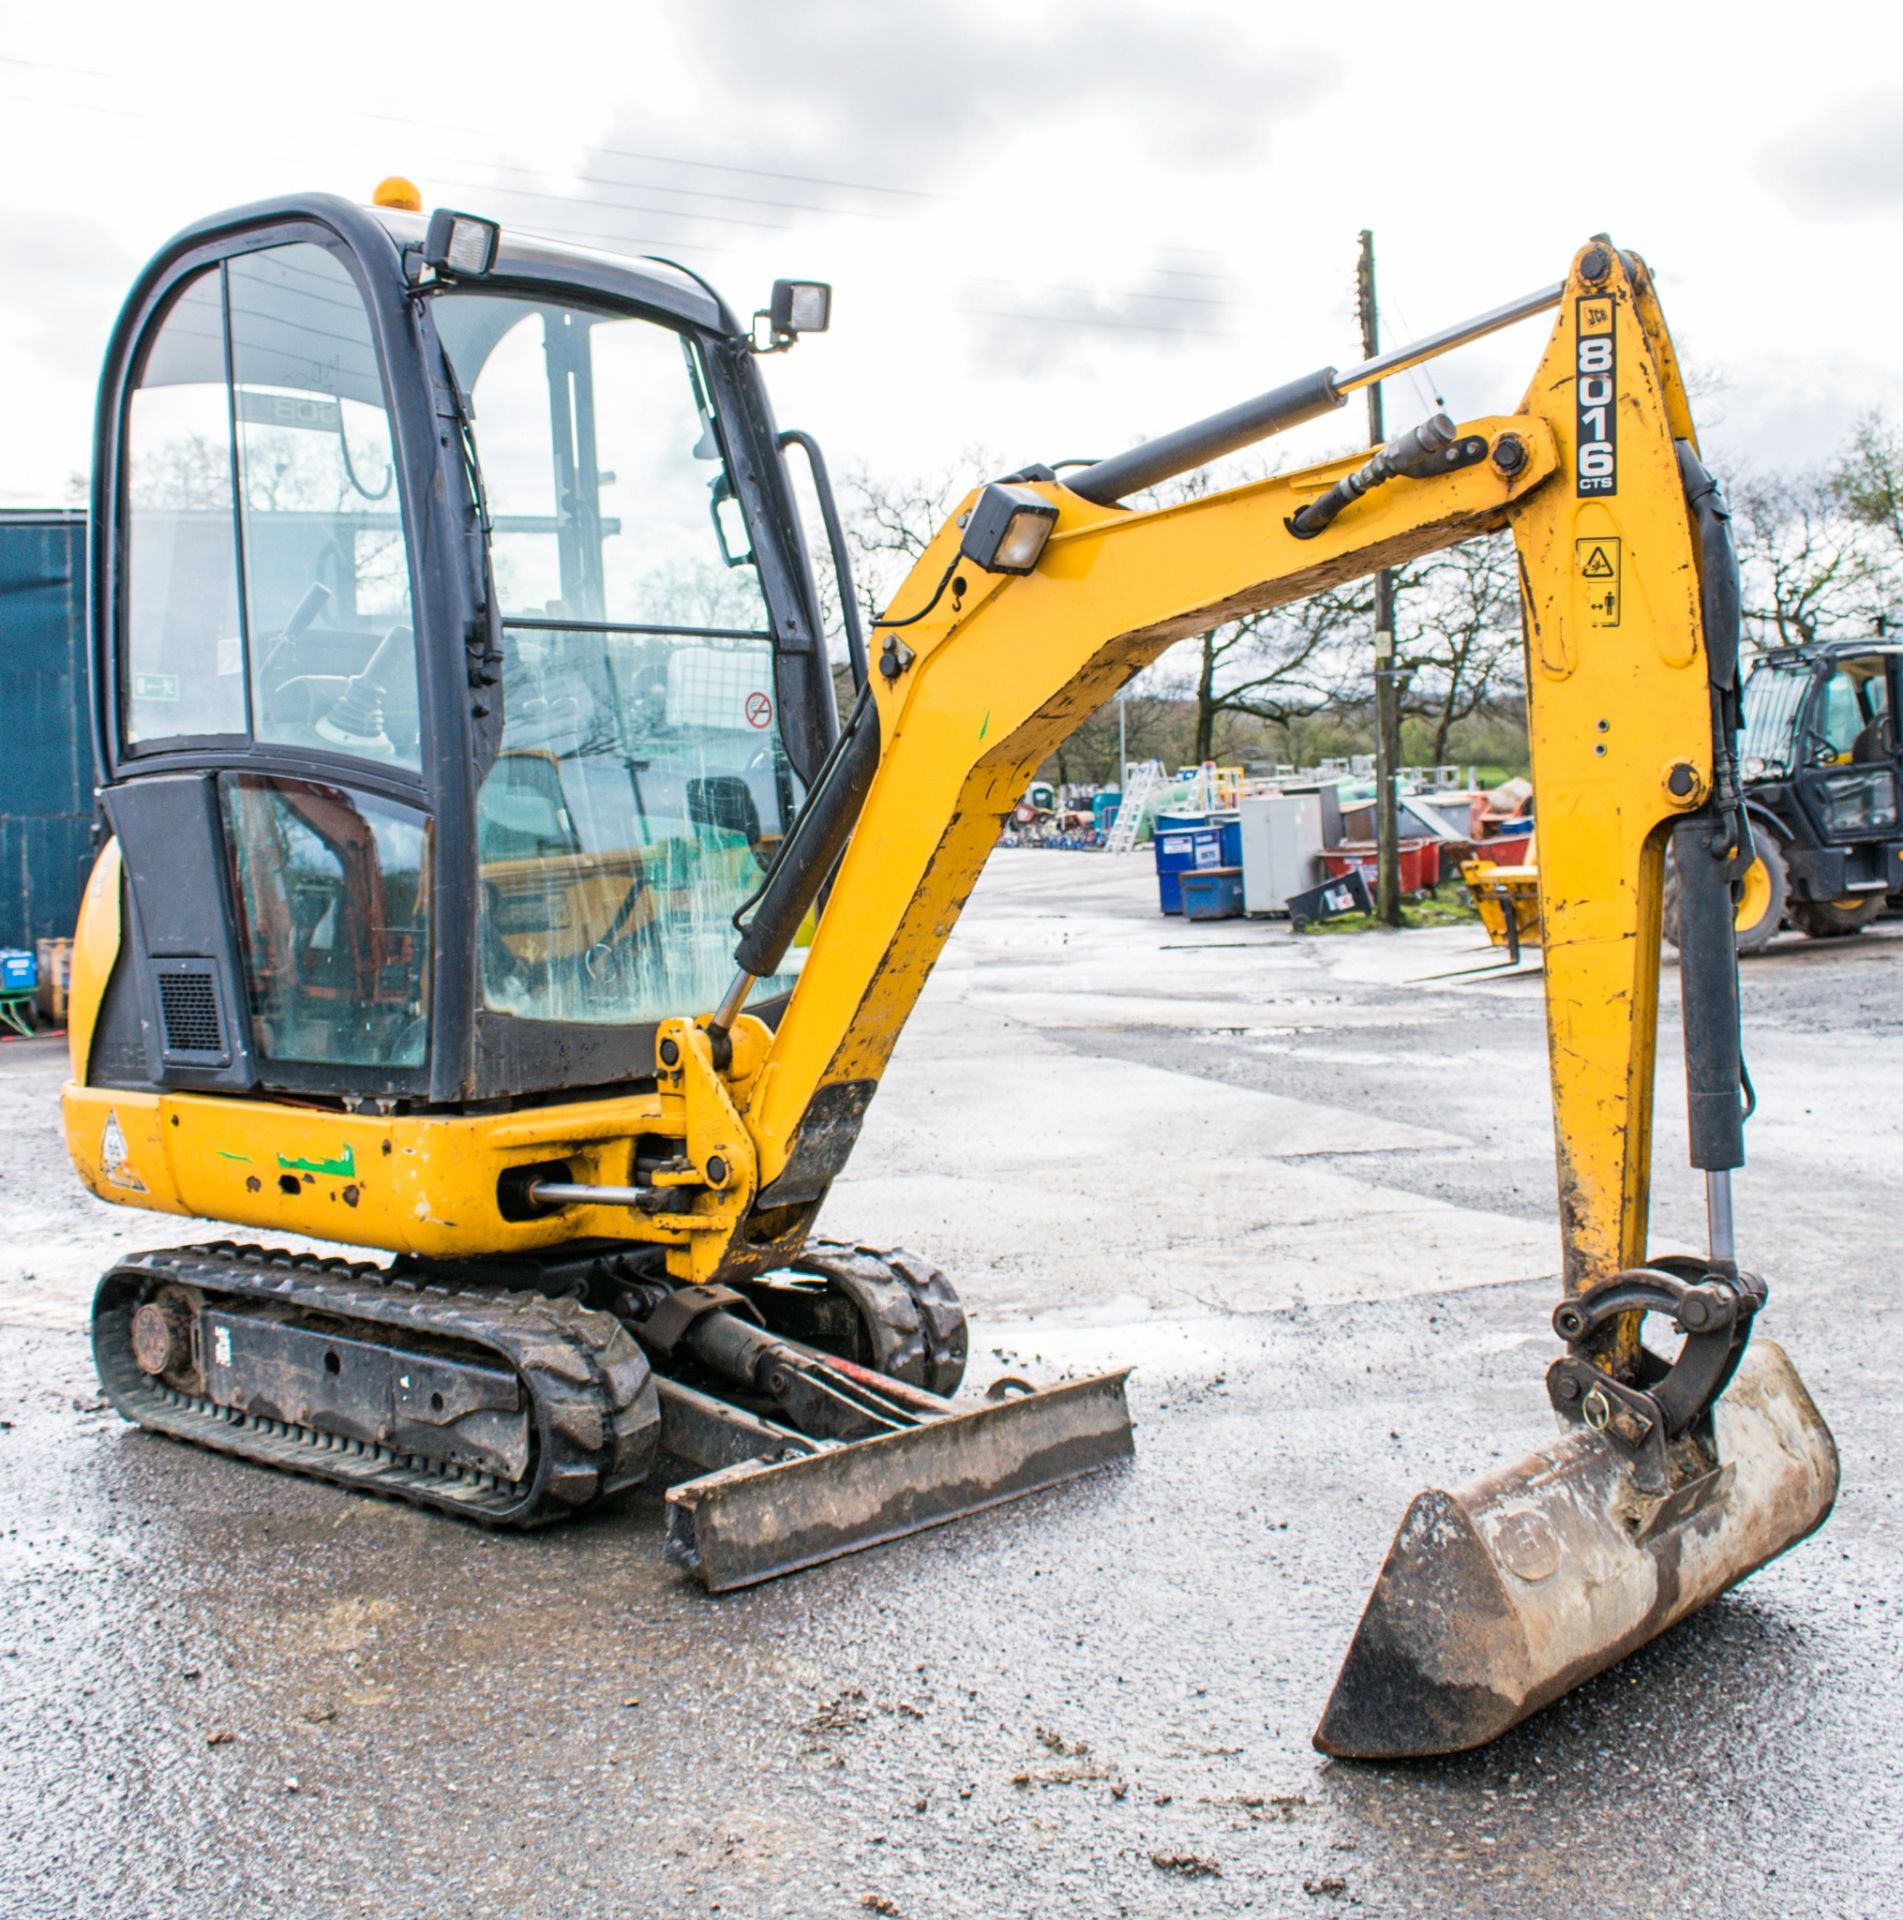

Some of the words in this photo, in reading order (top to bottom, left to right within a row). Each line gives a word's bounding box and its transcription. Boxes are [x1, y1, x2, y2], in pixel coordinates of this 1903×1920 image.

[1587, 308, 1607, 326] JCB
[1578, 337, 1613, 478] 8016
[1579, 477, 1613, 490] CTS
